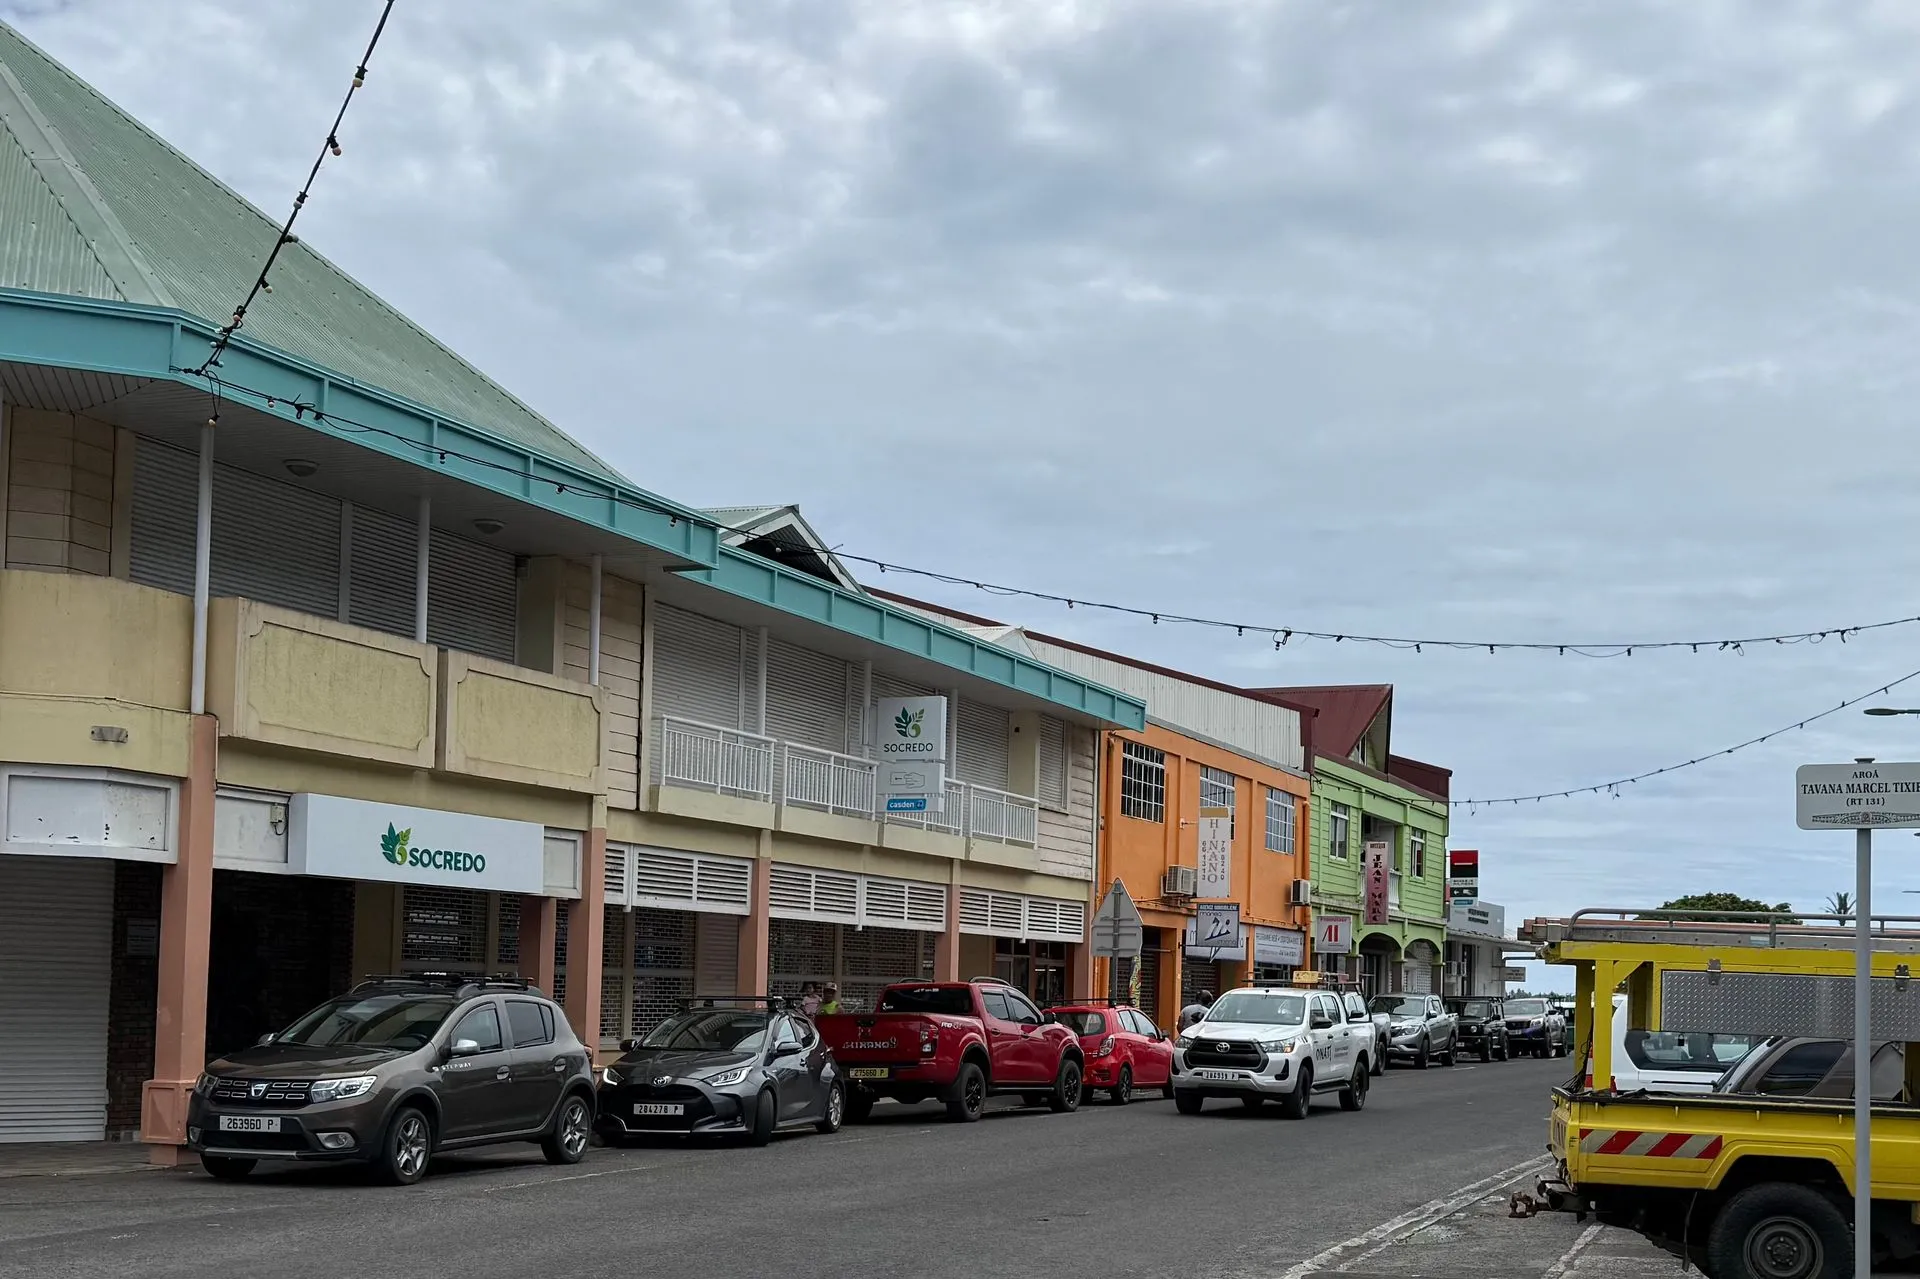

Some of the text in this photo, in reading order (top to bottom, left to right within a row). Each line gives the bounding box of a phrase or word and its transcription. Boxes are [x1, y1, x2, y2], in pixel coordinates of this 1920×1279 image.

[883, 742, 934, 753] SOCREDO
[1801, 783, 1843, 795] TAVANA
[1845, 782, 1891, 794] MARCEL
[889, 800, 915, 809] casden
[1846, 797, 1885, 807] (RT 131)
[1207, 819, 1219, 883] HINANO
[409, 847, 486, 873] SOCREDO
[226, 1117, 274, 1130] 263960 P
